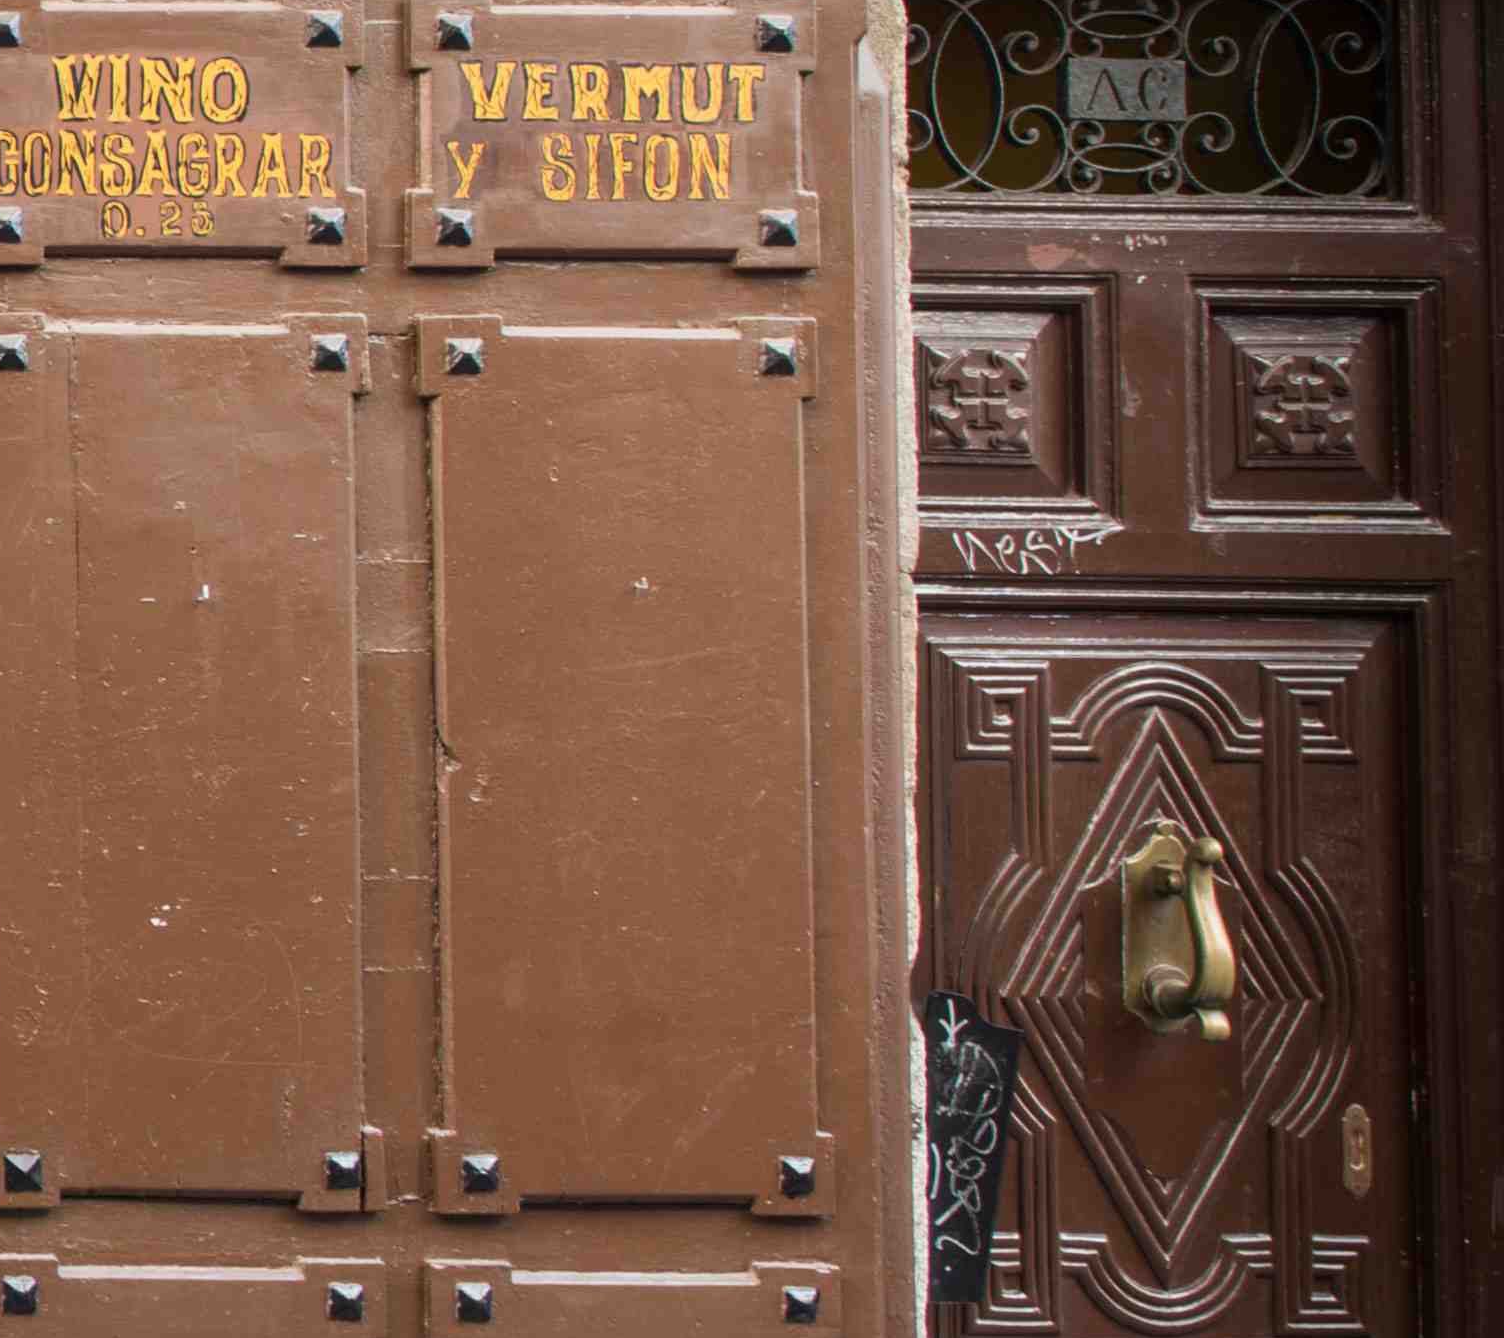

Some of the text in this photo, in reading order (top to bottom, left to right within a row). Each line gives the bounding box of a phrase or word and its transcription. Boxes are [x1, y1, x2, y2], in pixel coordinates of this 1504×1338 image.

[51, 52, 250, 125] VINO
[460, 60, 767, 123] VERMUT
[447, 131, 737, 203] Y SIFON
